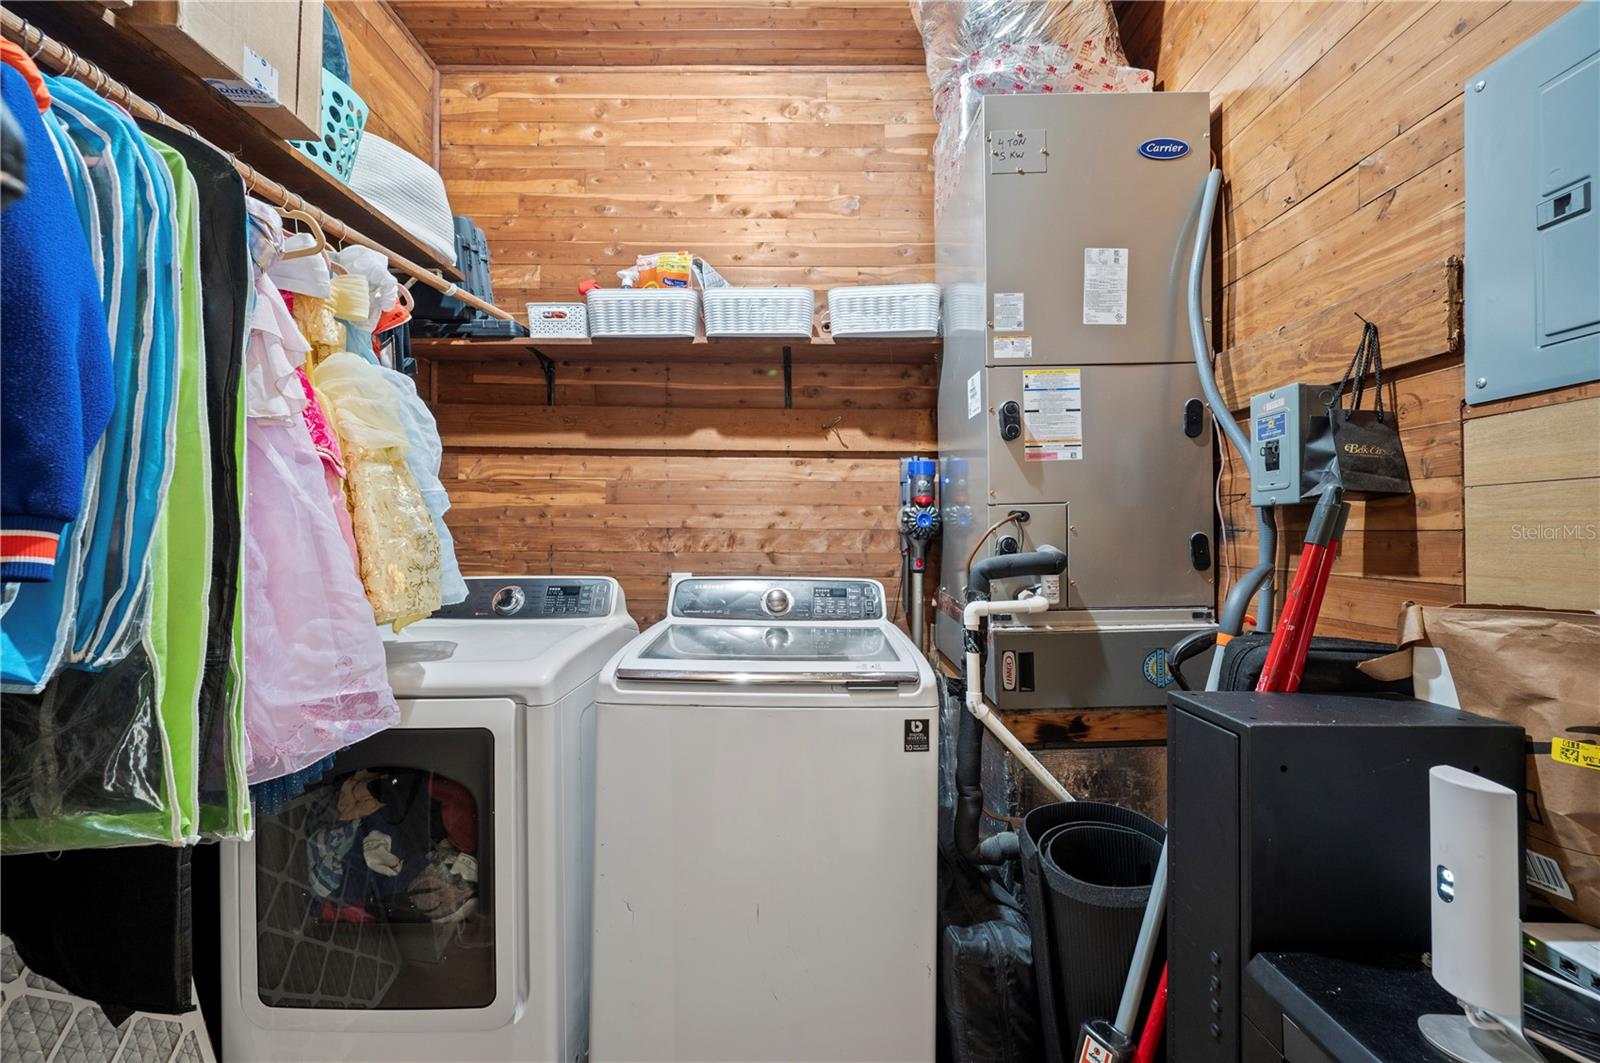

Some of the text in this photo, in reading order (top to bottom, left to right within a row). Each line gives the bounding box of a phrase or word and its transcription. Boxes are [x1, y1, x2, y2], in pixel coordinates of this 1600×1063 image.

[1007, 137, 1027, 148] TON
[1146, 142, 1184, 153] Carrier
[1009, 151, 1025, 159] KW
